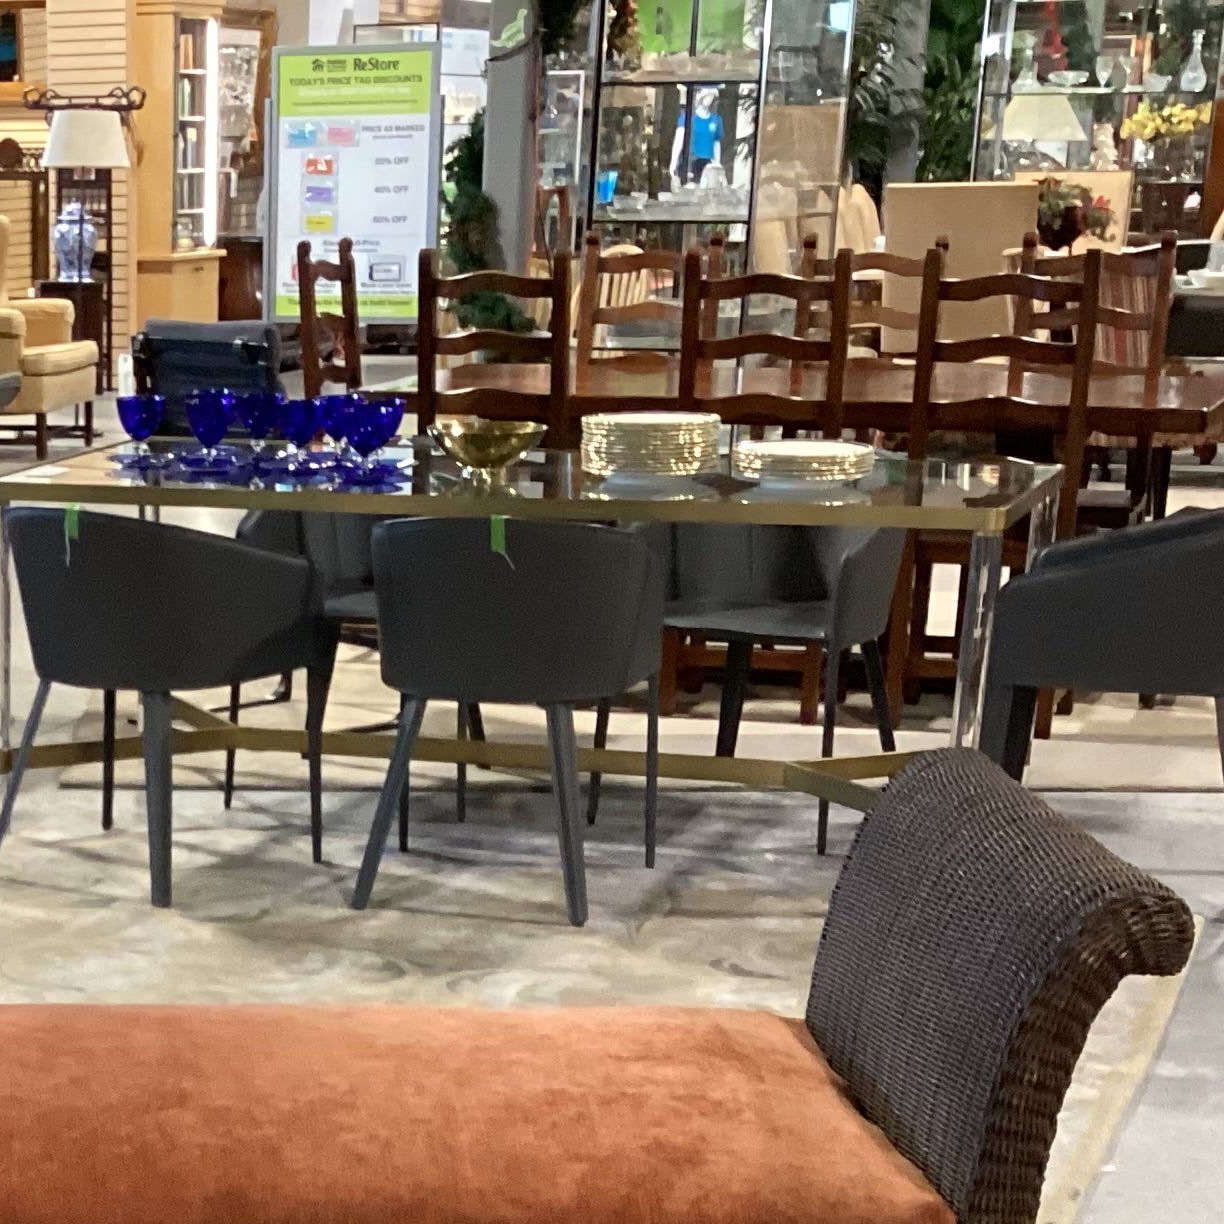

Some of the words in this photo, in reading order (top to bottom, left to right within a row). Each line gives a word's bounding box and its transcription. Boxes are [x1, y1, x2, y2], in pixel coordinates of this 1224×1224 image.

[353, 57, 400, 72] ReStore
[327, 77, 351, 85] PRICE
[354, 76, 372, 85] TAG
[373, 74, 423, 84] DISCOUNTS
[393, 156, 409, 165] OFF
[392, 185, 409, 194] OFF
[392, 215, 408, 224] OFF
